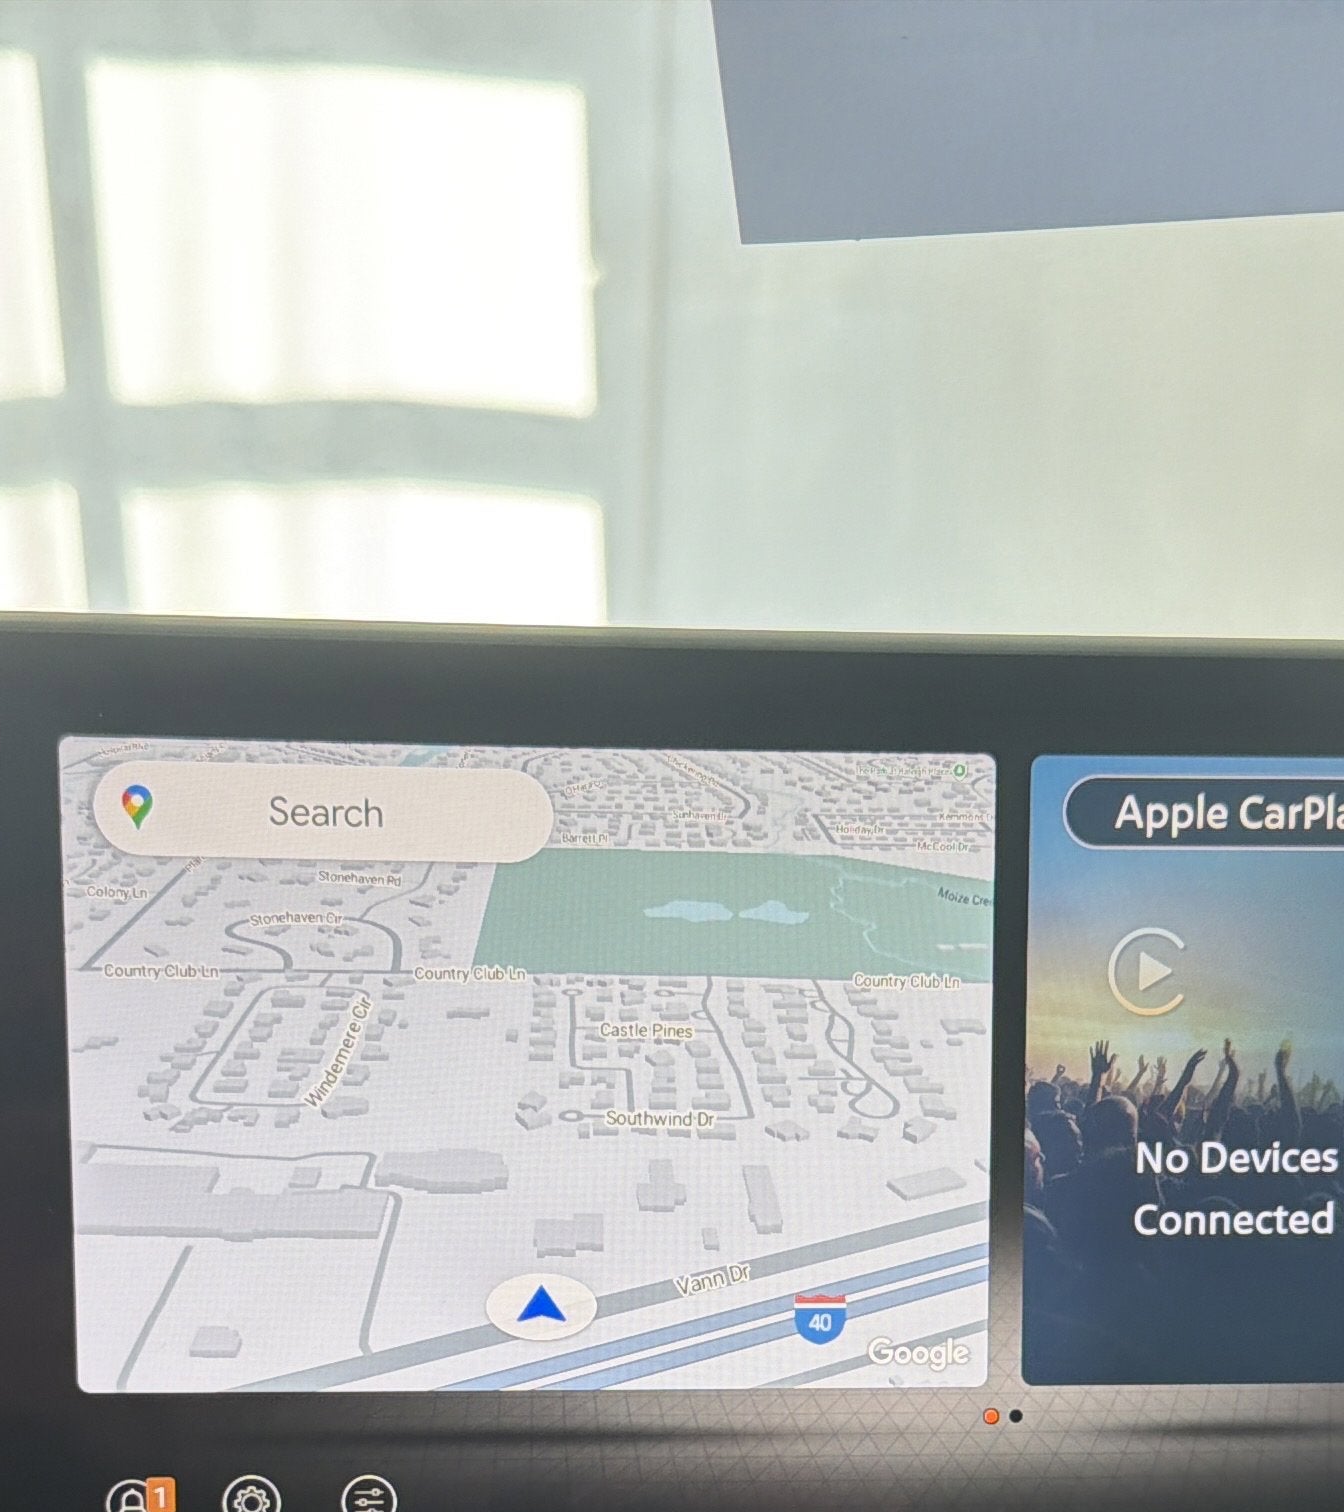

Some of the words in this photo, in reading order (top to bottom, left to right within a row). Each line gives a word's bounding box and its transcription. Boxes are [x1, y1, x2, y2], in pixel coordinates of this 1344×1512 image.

[268, 795, 384, 829] Search
[1114, 792, 1229, 839] Apple
[318, 871, 384, 886] Stonehaven
[386, 875, 402, 887] Rd
[87, 885, 129, 900] Colony
[132, 887, 148, 899] Ln
[250, 911, 323, 927] Stonehaven
[104, 964, 161, 980] Country
[164, 964, 197, 978] Club
[201, 965, 219, 978] Ln
[414, 966, 470, 983] Country
[474, 966, 505, 981] Club
[509, 968, 526, 981] Ln
[854, 973, 907, 990] Country
[910, 975, 941, 989] Club
[944, 976, 961, 989] Ln
[600, 1022, 648, 1039] Castle
[652, 1024, 693, 1039] Pines
[304, 1021, 361, 1108] Windemere
[351, 997, 372, 1021] Cir
[606, 1110, 692, 1128] Southwind
[697, 1112, 715, 1127] Dr
[1136, 1142, 1189, 1174] No
[1201, 1141, 1339, 1175] Devices
[1133, 1201, 1335, 1236] Connected
[676, 1271, 725, 1297] Vann
[728, 1265, 751, 1285] Dr
[809, 1313, 832, 1332] 40
[867, 1337, 971, 1371] Google
[154, 1485, 168, 1509] 1
